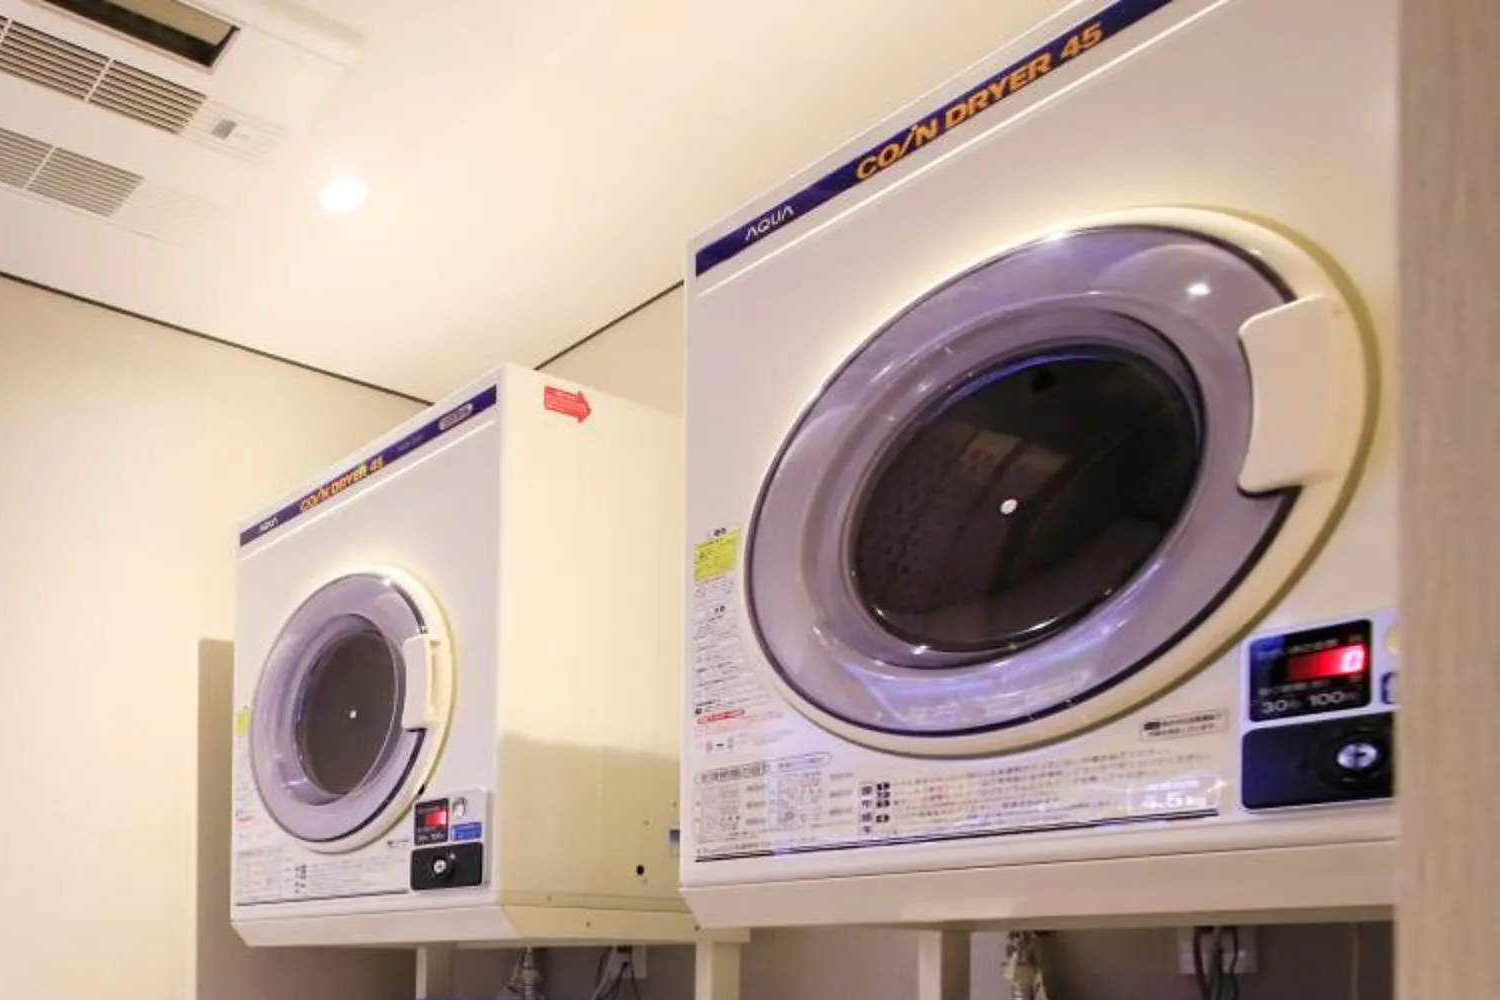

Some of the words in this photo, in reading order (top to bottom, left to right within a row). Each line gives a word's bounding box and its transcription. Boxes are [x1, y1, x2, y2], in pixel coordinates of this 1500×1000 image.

[745, 205, 794, 241] AQUA
[945, 53, 1051, 130] DRYER
[1060, 24, 1104, 60] 45
